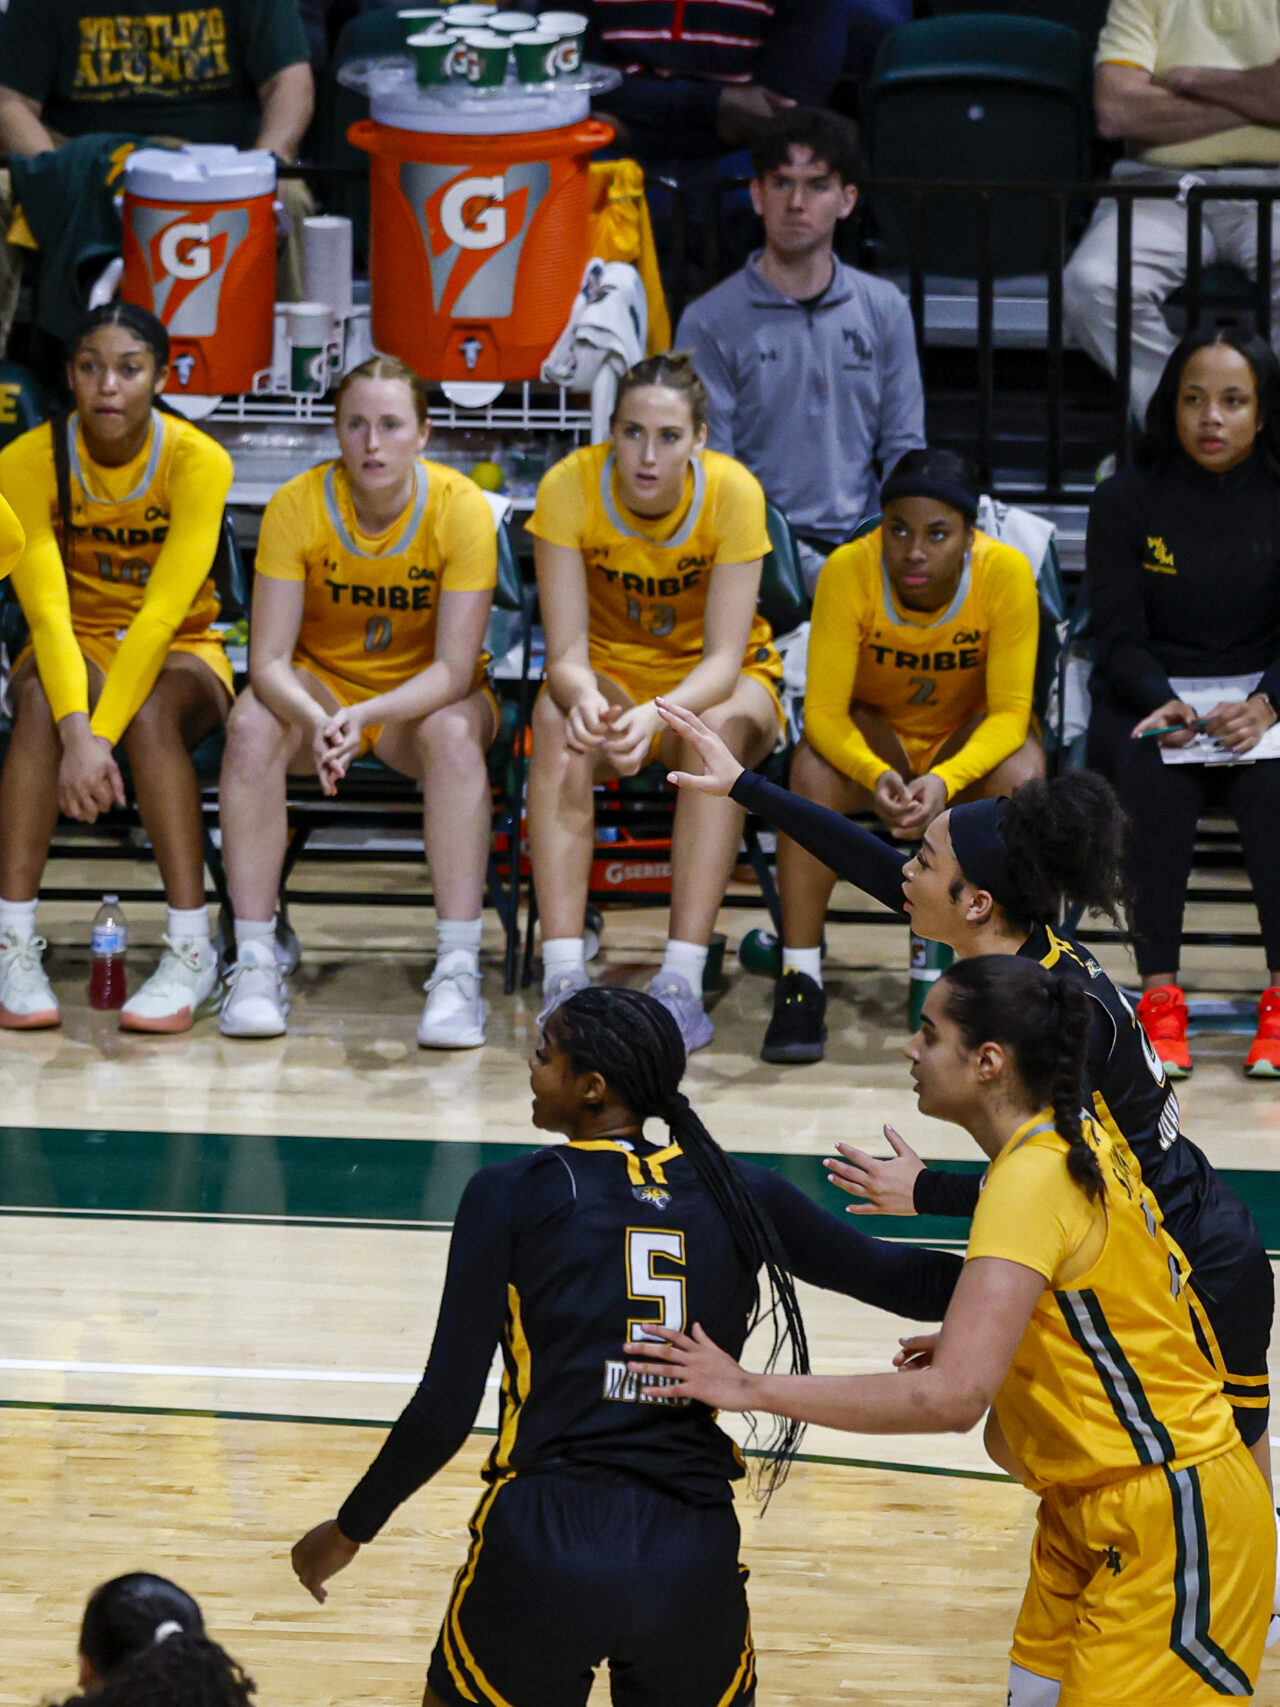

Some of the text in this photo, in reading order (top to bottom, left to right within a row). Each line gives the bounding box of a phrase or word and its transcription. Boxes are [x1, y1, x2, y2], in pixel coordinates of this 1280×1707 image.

[440, 175, 506, 250] G
[160, 223, 211, 280] G
[324, 578, 433, 612] TRIBE
[595, 563, 702, 597] TRIBE
[363, 615, 393, 653] 0
[624, 593, 678, 637] 13
[868, 643, 980, 672] TRIBE
[906, 676, 938, 706] 2
[624, 1225, 688, 1347] 5
